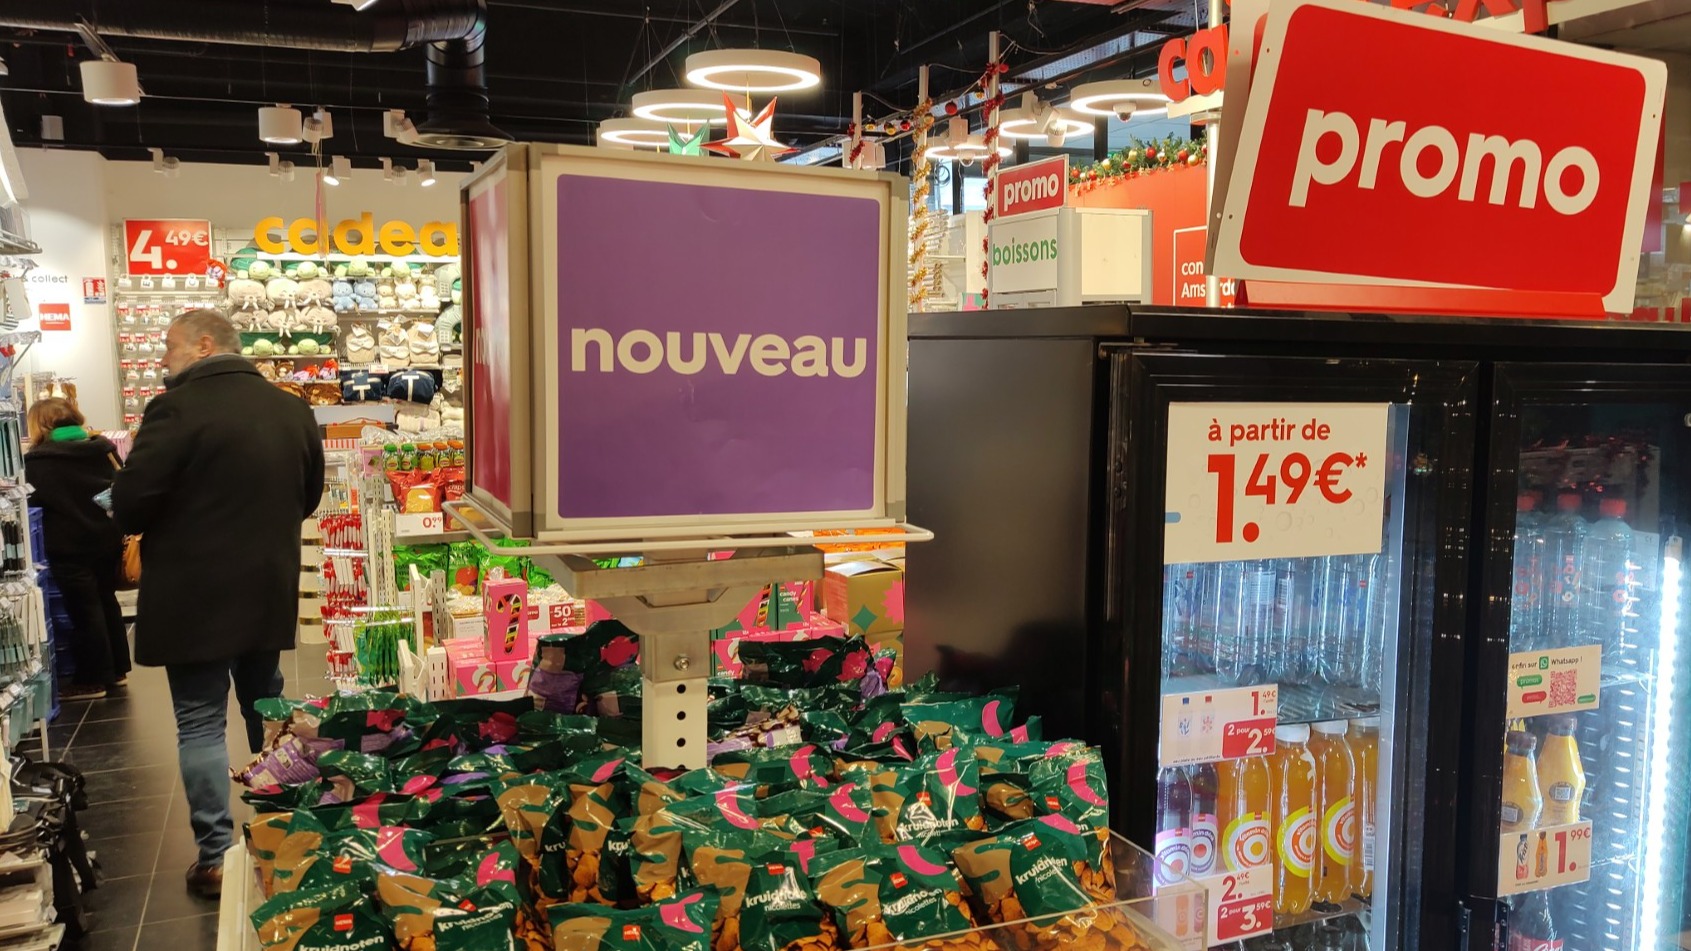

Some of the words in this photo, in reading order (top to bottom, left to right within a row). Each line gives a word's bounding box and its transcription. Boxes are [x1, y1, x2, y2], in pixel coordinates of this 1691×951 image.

[1288, 108, 1600, 216] promo
[1003, 173, 1059, 211] promo
[254, 211, 459, 257] cadea
[992, 236, 1058, 267] boissons
[31, 275, 68, 283] collect
[1181, 261, 1204, 275] con
[39, 313, 70, 321] HEMA
[571, 327, 868, 379] nouveau
[1208, 418, 1223, 442] à
[1230, 417, 1296, 447] partir
[1301, 418, 1331, 441] de
[1528, 661, 1538, 669] sur
[1551, 656, 1579, 666] Whatsapp
[1227, 724, 1235, 736] 2
[1236, 727, 1250, 737] pour
[1220, 907, 1229, 919] 2
